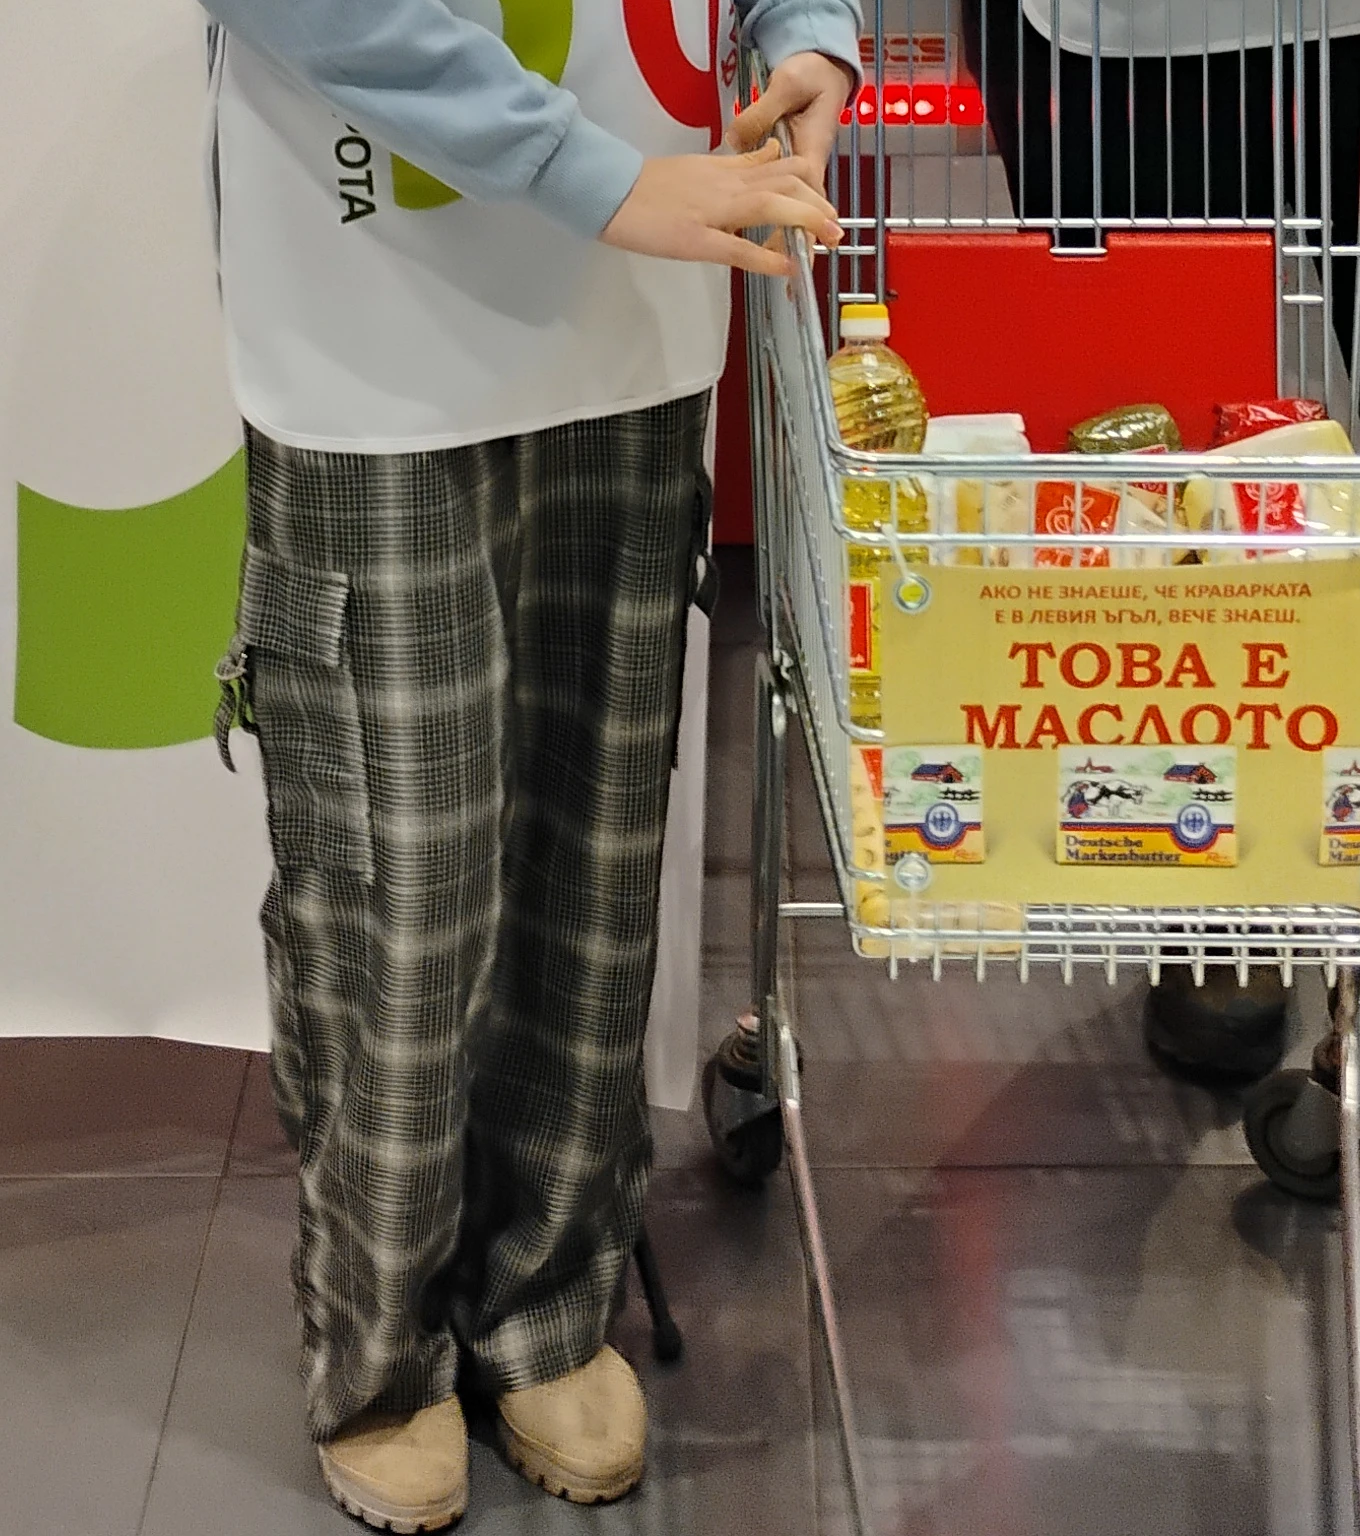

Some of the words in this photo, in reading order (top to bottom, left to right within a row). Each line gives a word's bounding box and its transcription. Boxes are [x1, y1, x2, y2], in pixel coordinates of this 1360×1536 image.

[857, 37, 952, 63] SCS
[979, 585, 1021, 600] АКО
[1027, 585, 1053, 600] НЕ
[1058, 585, 1148, 602] ЗНАЕШЕ,
[1154, 584, 1178, 599] ЧЕ
[1185, 582, 1312, 599] КРАВАРКАТА
[995, 610, 1006, 624] Е
[1012, 610, 1023, 624] В
[1029, 610, 1096, 624] ЛЕВИЯ
[1103, 609, 1162, 627] ЪГЪЛ,
[1168, 609, 1216, 624] ВЕЧЕ
[1221, 608, 1301, 624] ЗНАЕШ.
[1007, 641, 1216, 690] ТОВА
[1241, 642, 1291, 689] Е
[960, 702, 1339, 752] МАСЛОТО
[1065, 835, 1143, 848] Deutsche
[1065, 849, 1182, 863] Markenbutter
